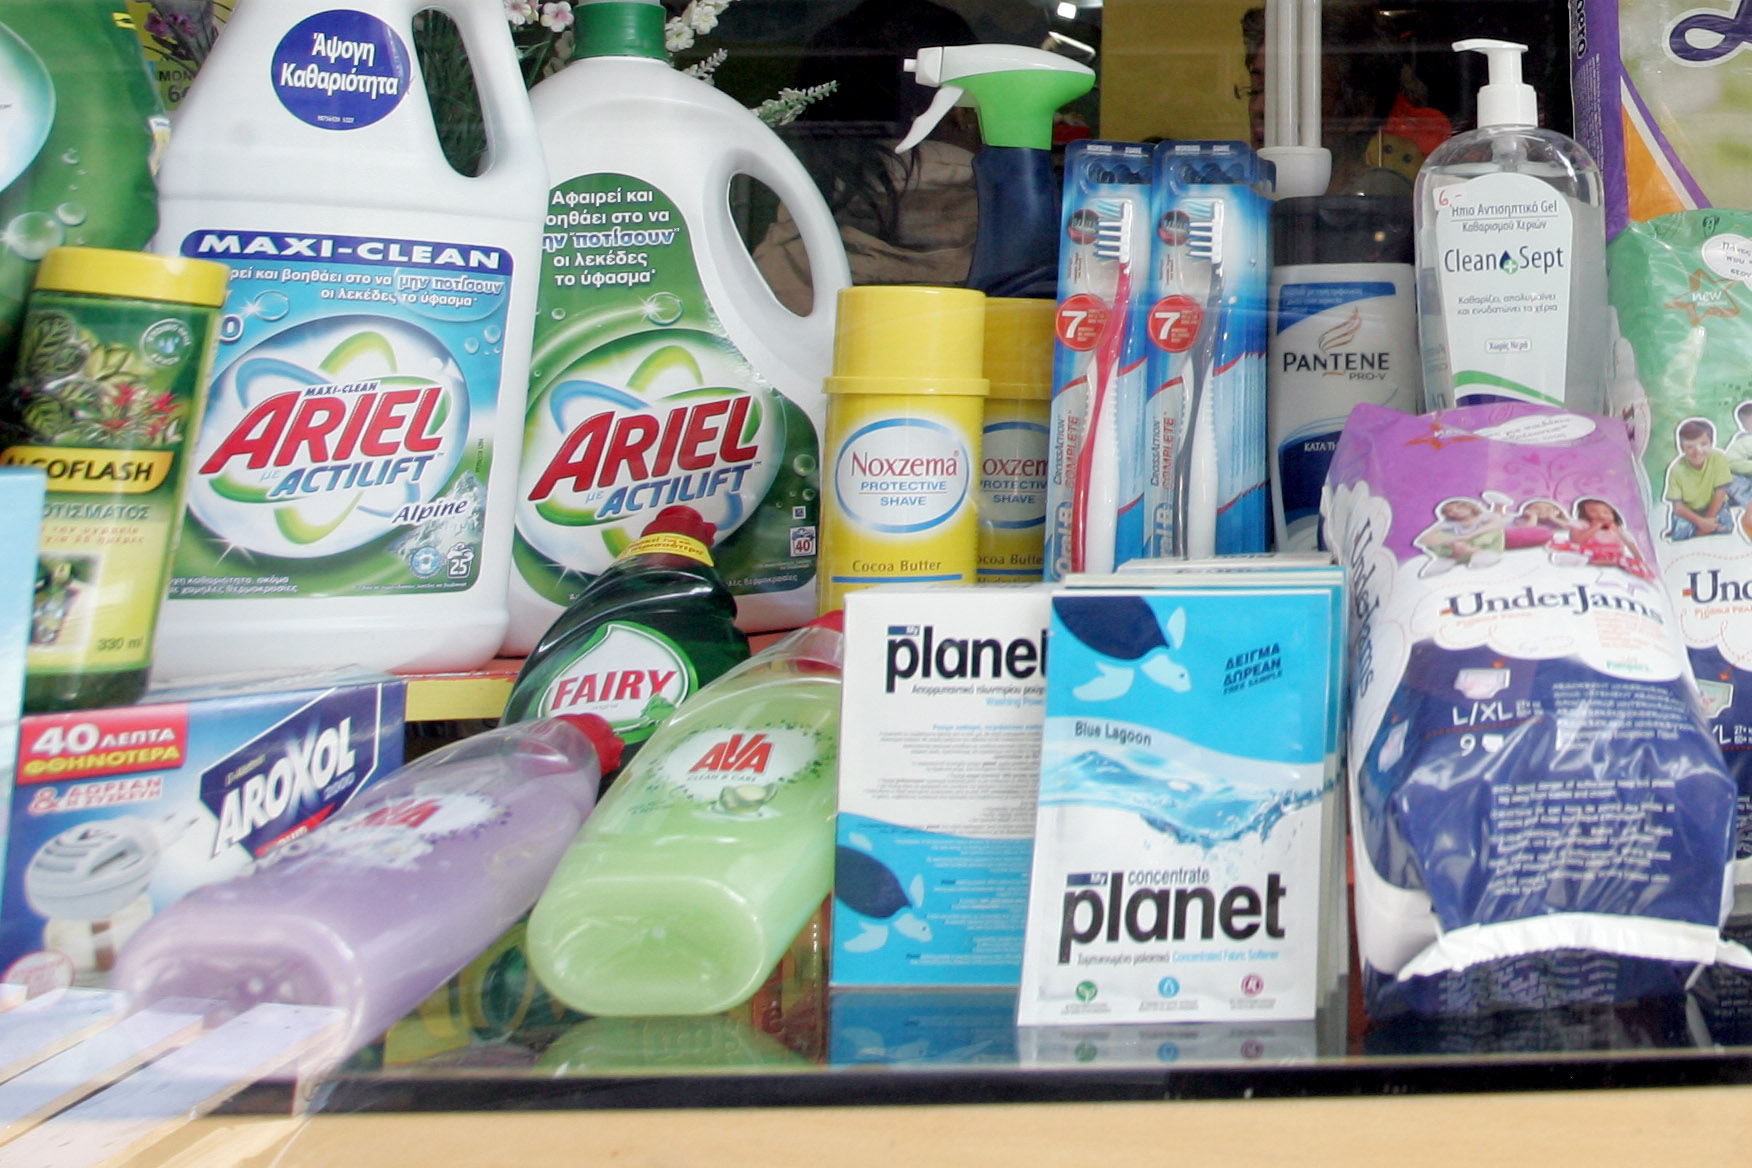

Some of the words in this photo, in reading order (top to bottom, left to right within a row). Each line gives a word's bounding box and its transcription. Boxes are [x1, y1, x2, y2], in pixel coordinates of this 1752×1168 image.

[312, 33, 375, 68] Άψογη
[280, 63, 398, 99] Καθαριότητα
[552, 187, 622, 207] Αφαιρεί
[627, 190, 653, 203] και
[1477, 201, 1538, 217] Αντισηπτικό
[1541, 200, 1558, 212] Gel
[611, 211, 643, 224] στο
[649, 210, 669, 222] να
[1462, 220, 1514, 233] Καθαρισμού
[1516, 218, 1547, 232] Χεριών
[198, 234, 500, 270] MAXI-CLEAN
[553, 255, 570, 267] οι
[574, 250, 648, 267] λεκέδες
[1444, 248, 1497, 273] Clean
[1518, 245, 1565, 275] Sept
[281, 268, 342, 286] βοηθάει
[345, 274, 371, 285] στο
[375, 275, 392, 285] να
[555, 274, 576, 286] το
[320, 289, 335, 299] οι
[338, 289, 397, 304] λεκέδες
[401, 293, 417, 303] το
[1691, 290, 1723, 302] new
[1061, 310, 1088, 339] 7
[1153, 310, 1181, 340] 7
[1284, 352, 1391, 372] PANTENE
[1349, 372, 1386, 381] PRO-V
[200, 387, 444, 475] ARIEL
[529, 395, 759, 501] ARIEL
[266, 455, 434, 498] ACTILIFT
[852, 451, 957, 477] Noxzema
[596, 462, 751, 519] ACTILIFT
[860, 480, 947, 492] PROTECTIVE
[993, 494, 1036, 504] SHAVE
[392, 497, 468, 524] Alpine
[880, 496, 926, 506] SHAVE
[795, 539, 811, 552] 40
[451, 556, 468, 576] 25
[852, 559, 896, 573] Cocoa
[901, 559, 942, 572] Butter
[1446, 585, 1664, 625] UnderJams
[1225, 643, 1280, 671] ΔΕΙΓΜΑ
[1223, 657, 1281, 686] ΔΩΡΕΑΝ
[551, 669, 677, 711] FAIRY
[1453, 701, 1513, 726] L/XL
[29, 722, 100, 757] 40
[100, 727, 176, 749] ΛΕΠΤΑ
[1074, 721, 1101, 739] Blue
[1105, 723, 1153, 747] Lagoon
[24, 746, 181, 776] ΦΘΗΝΟΤΕΡΑ
[689, 734, 775, 773] AVA
[212, 717, 357, 860] AROXOL
[1127, 867, 1211, 886] concentrate
[1058, 872, 1287, 965] planet
